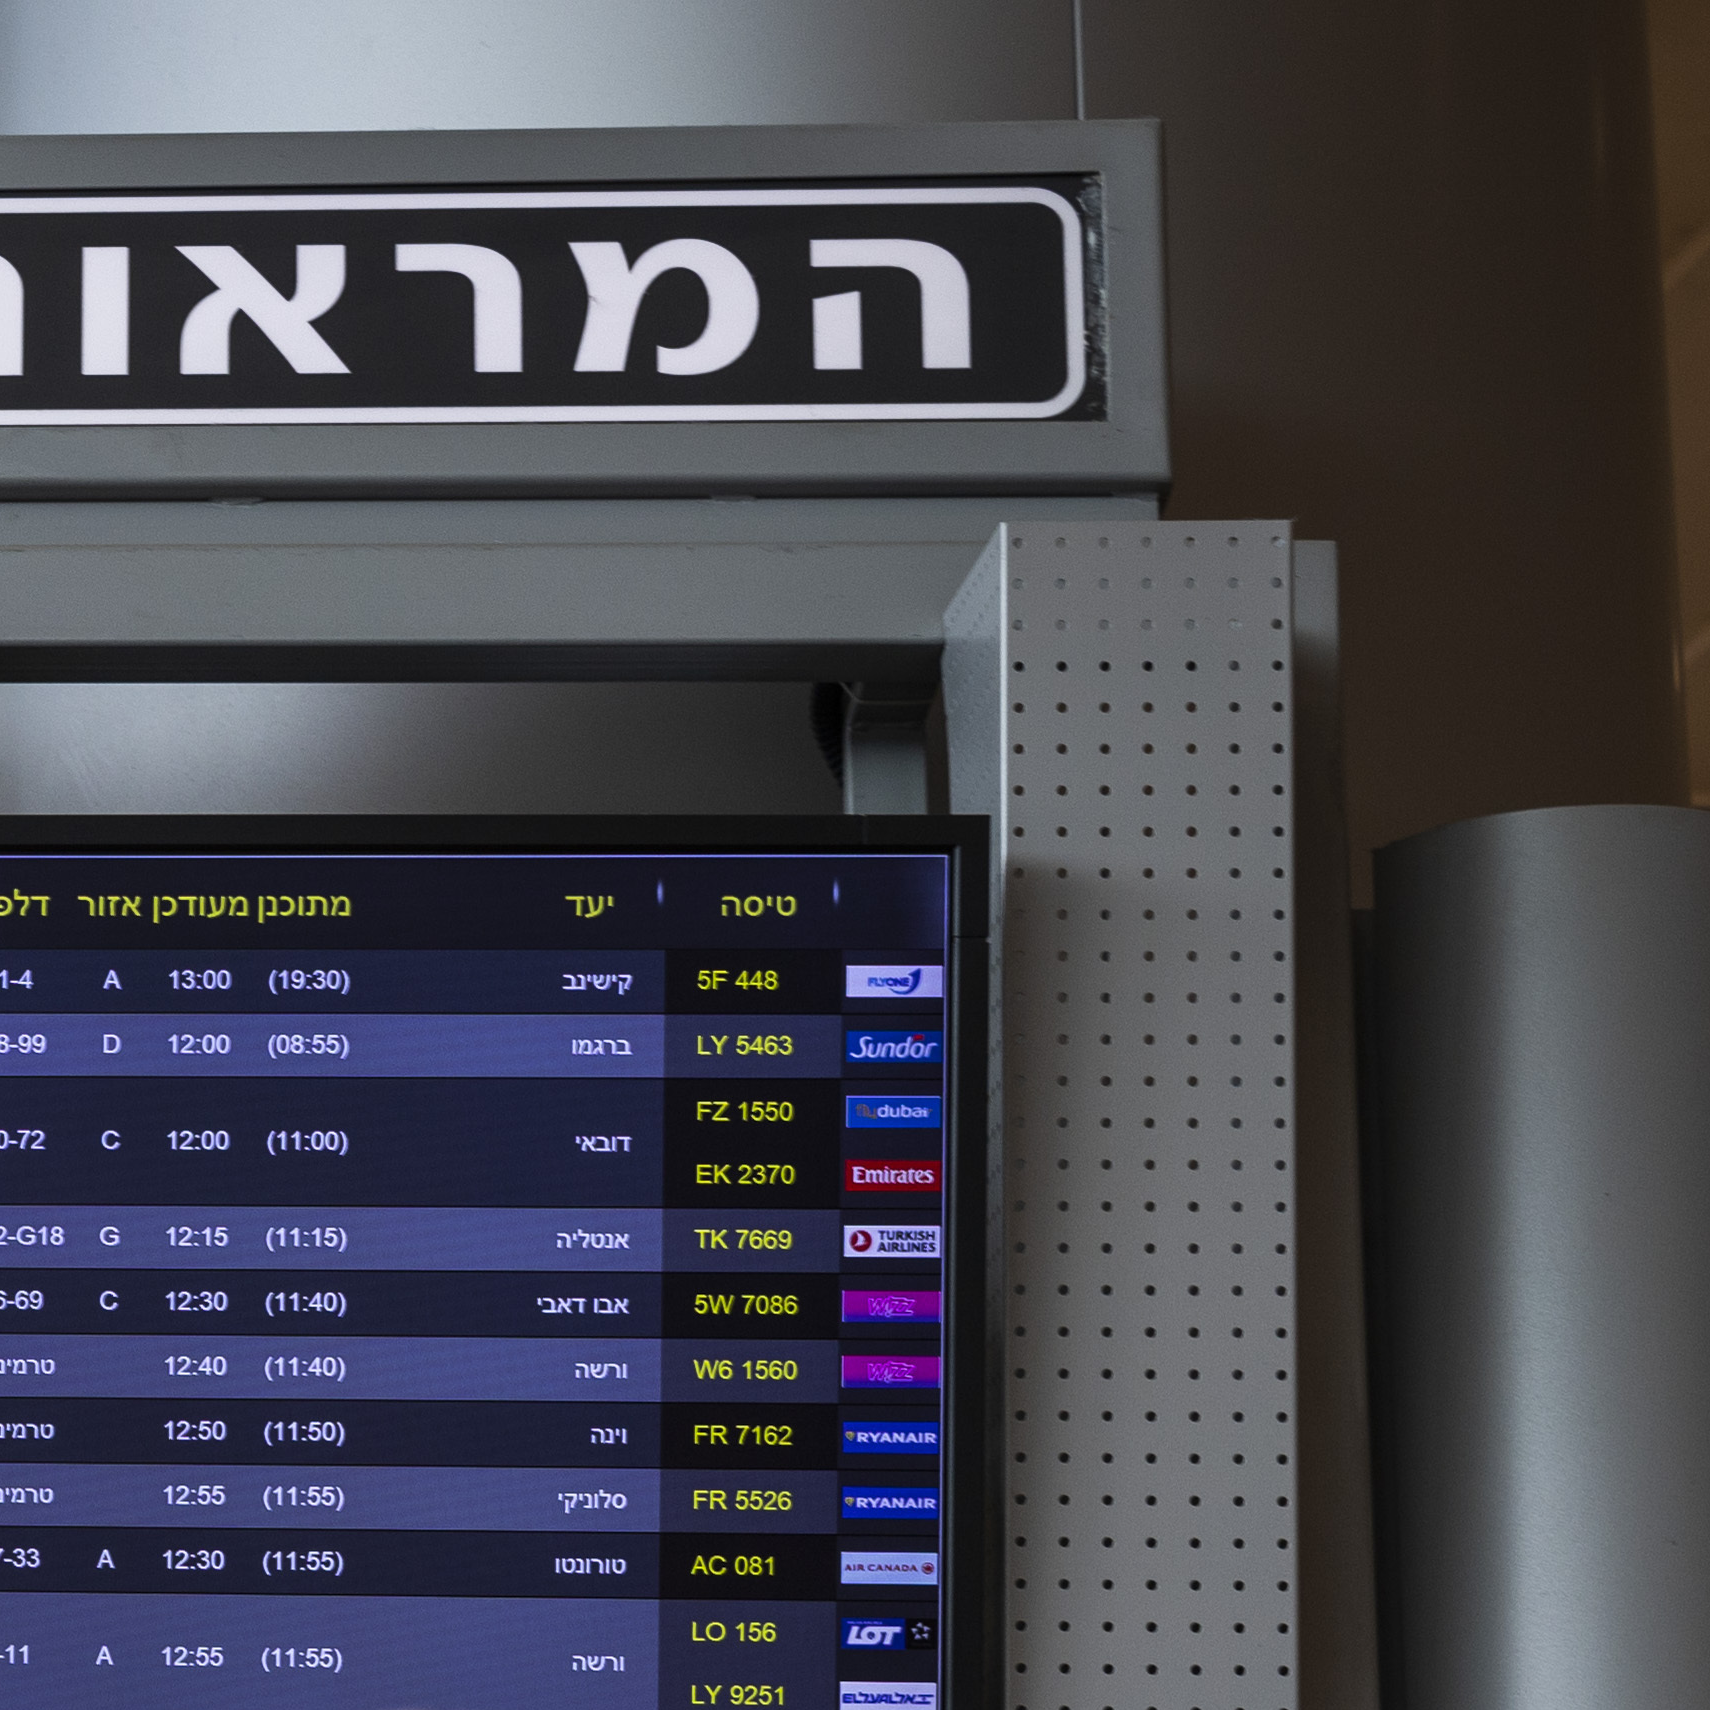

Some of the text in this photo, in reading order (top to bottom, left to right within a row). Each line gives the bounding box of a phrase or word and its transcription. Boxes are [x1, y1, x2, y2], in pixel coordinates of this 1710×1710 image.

[76, 895, 352, 925] מתוכנן מעודכן אזור
[564, 895, 615, 919] יעד
[720, 895, 798, 918] טיסה
[102, 969, 123, 990] A
[168, 969, 233, 990] 13:00
[268, 969, 351, 996] (19:30)
[561, 973, 634, 996] קישינב
[696, 969, 780, 991] 5F 448
[851, 1165, 935, 1184] Emirates
[99, 1289, 119, 1311] C
[164, 1290, 229, 1312] 12:30
[264, 1291, 348, 1318] (11:40)
[536, 1296, 630, 1315] אבו דאבי
[693, 1293, 800, 1316] 5W 7086
[856, 1431, 937, 1444] RYANAIR
[162, 1484, 227, 1506] 12:55
[262, 1485, 346, 1512] (11:55)
[557, 1488, 628, 1515] סלוניקי
[692, 1489, 793, 1511] FR 5526
[844, 1563, 918, 1572] AIR CANADA
